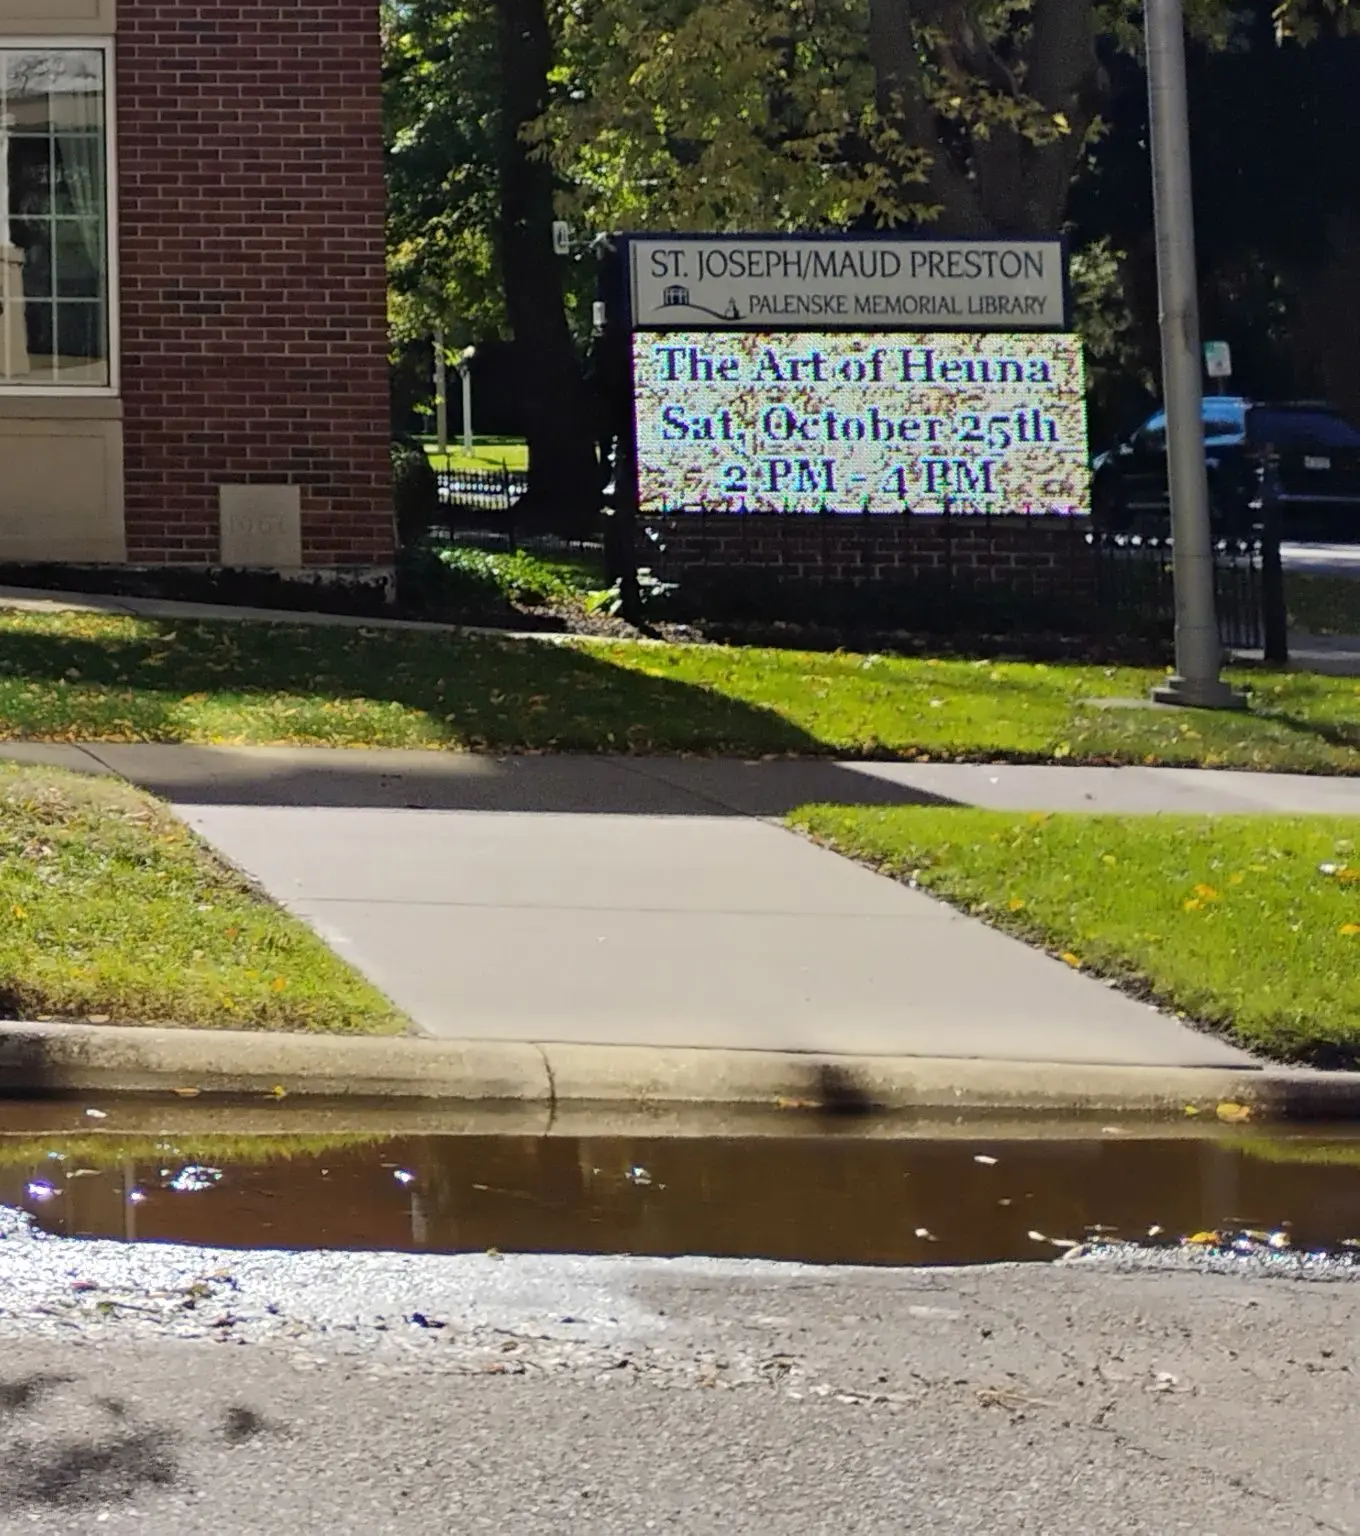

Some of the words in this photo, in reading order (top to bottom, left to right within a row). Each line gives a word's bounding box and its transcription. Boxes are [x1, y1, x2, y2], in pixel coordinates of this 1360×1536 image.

[650, 249, 689, 278] ST.
[697, 249, 901, 281] JOSEPH/MAUD
[910, 250, 1044, 279] PRESTON
[749, 294, 848, 314] PALENSKE
[854, 294, 963, 315] MEMORIAL
[968, 295, 1047, 316] LIBRARY
[654, 346, 740, 381] The
[756, 346, 828, 382] Art
[838, 346, 887, 382] of
[898, 347, 1053, 382] Henna
[662, 404, 746, 447] Sat,
[762, 404, 944, 442] October
[957, 407, 1059, 449] 25th
[722, 464, 749, 492] 2
[762, 458, 838, 493] PM
[881, 465, 909, 500] 4
[921, 457, 998, 494] PM
